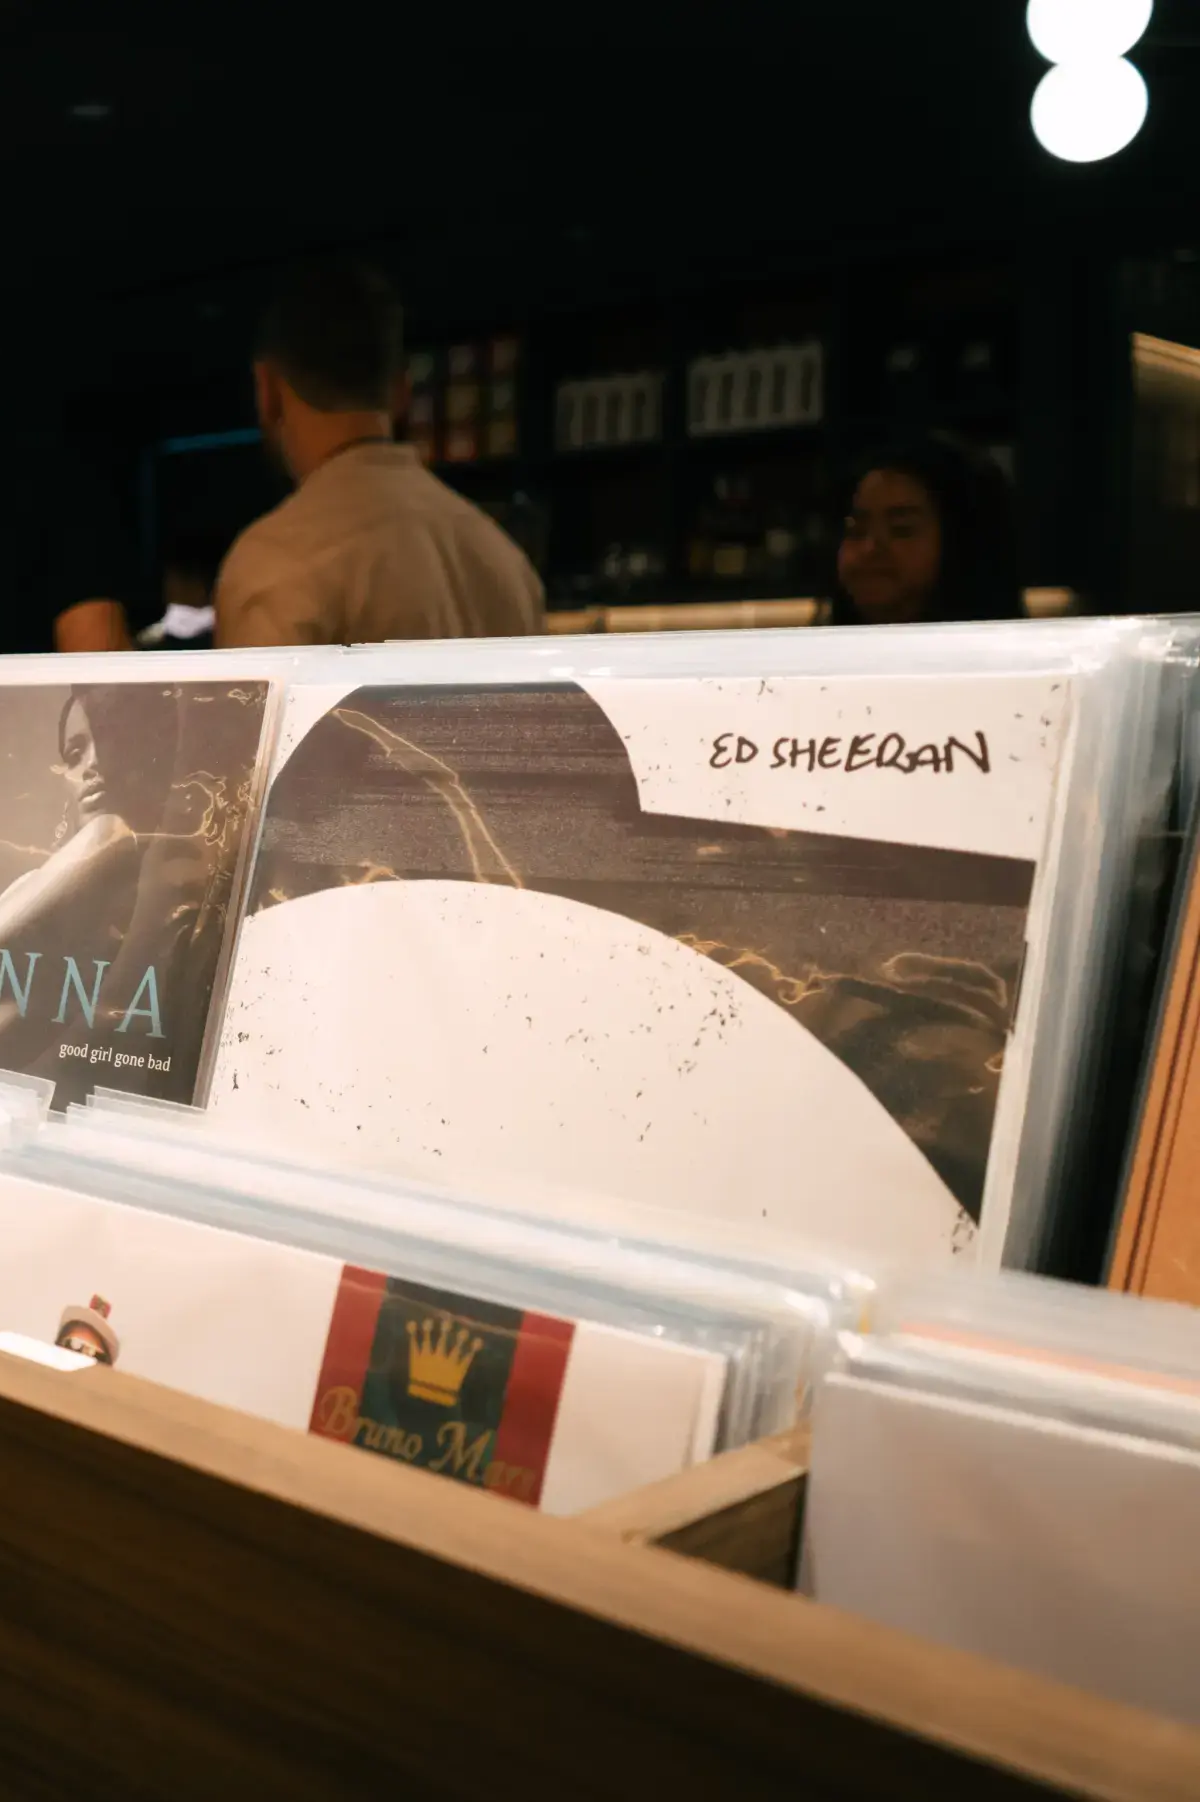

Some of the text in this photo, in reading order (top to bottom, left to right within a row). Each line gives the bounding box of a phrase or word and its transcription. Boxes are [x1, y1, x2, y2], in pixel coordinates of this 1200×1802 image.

[709, 730, 991, 774] ED SHEERAN
[58, 1043, 172, 1072] good girl gone bad
[317, 1385, 423, 1460] Bruno
